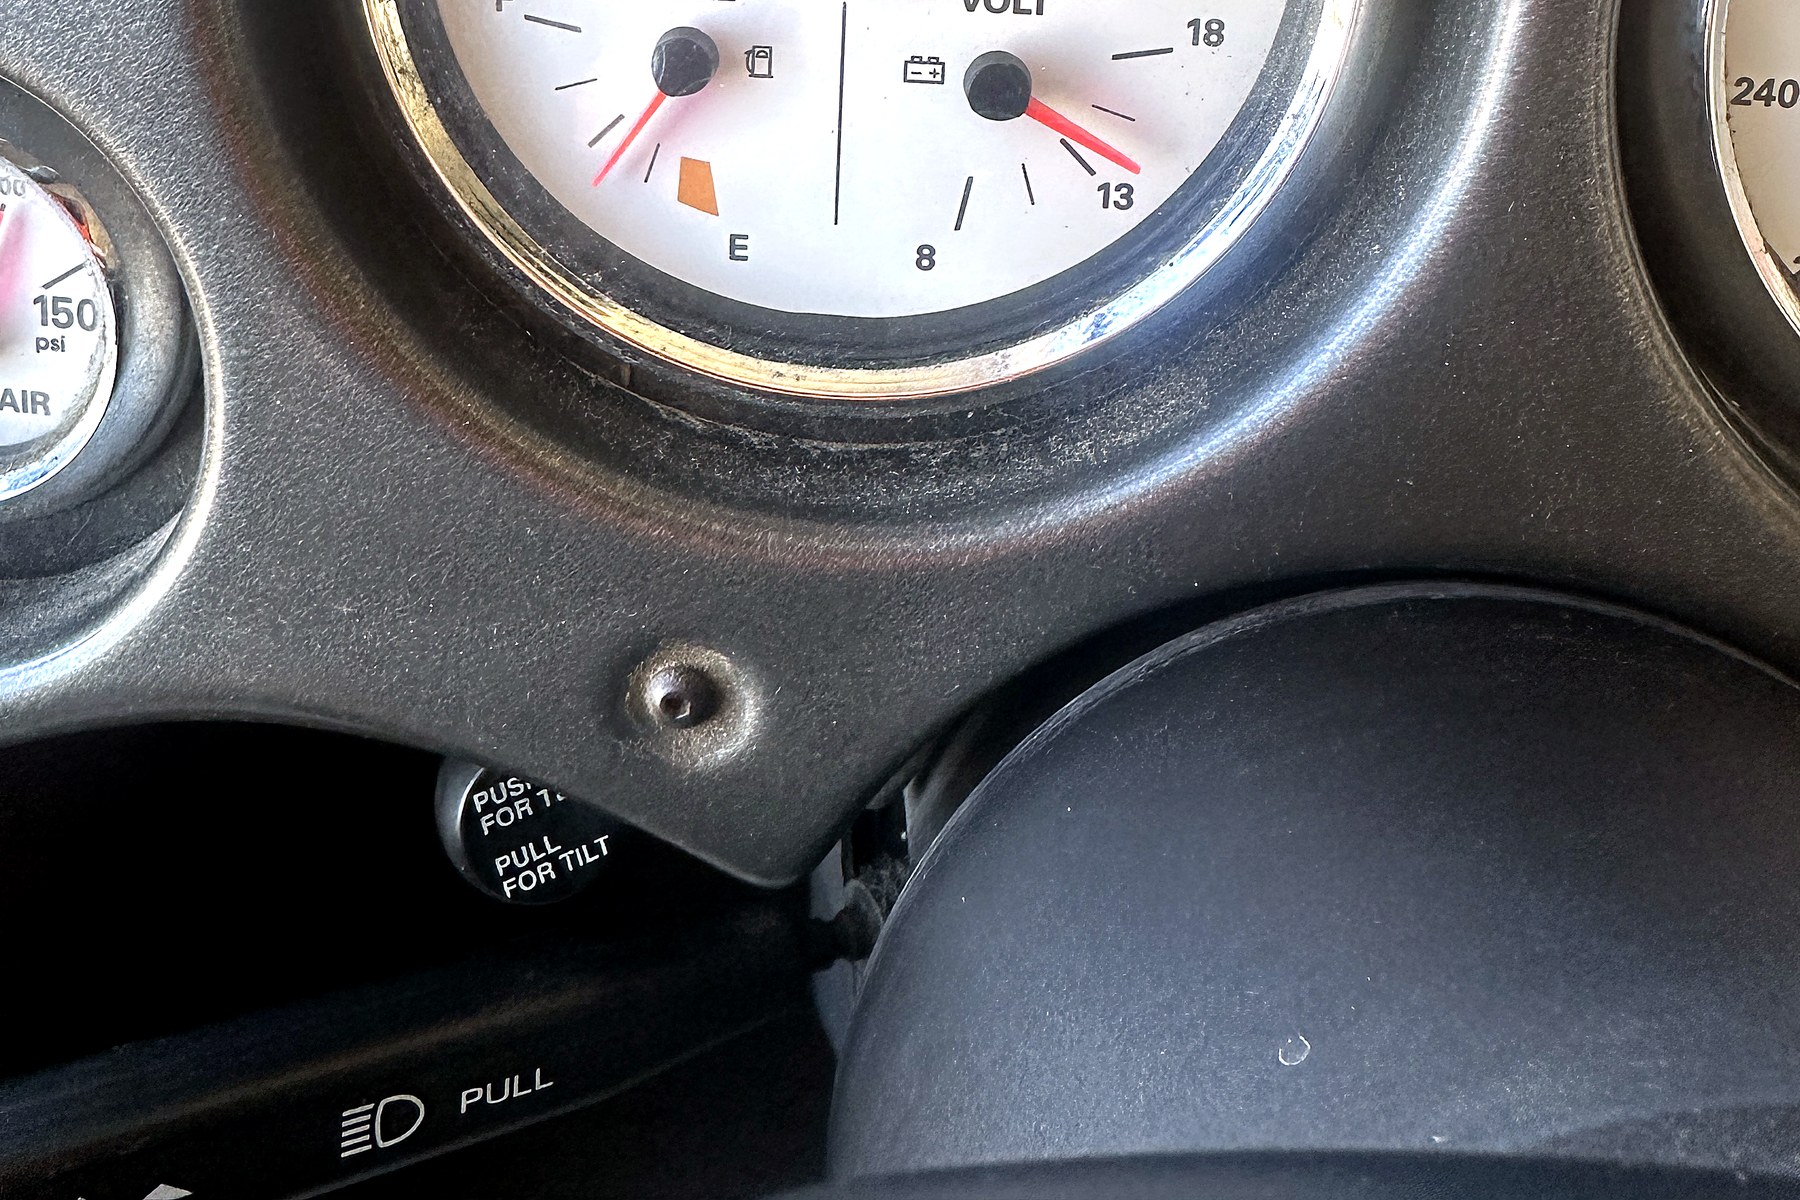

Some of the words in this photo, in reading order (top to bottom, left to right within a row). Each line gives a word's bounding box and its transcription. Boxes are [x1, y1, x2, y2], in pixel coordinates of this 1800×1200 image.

[1187, 19, 1225, 47] 18
[1730, 77, 1800, 109] 240
[1097, 183, 1135, 210] 13
[729, 234, 749, 261] E
[915, 244, 936, 271] 8
[33, 295, 97, 332] 150
[35, 335, 66, 354] psi
[0, 388, 51, 416] AIR
[473, 777, 532, 813] PUS
[479, 798, 533, 836] FOR
[495, 836, 562, 877] PULL
[502, 862, 556, 899] FOR
[558, 835, 609, 871] TILT
[460, 1067, 554, 1114] PULL
